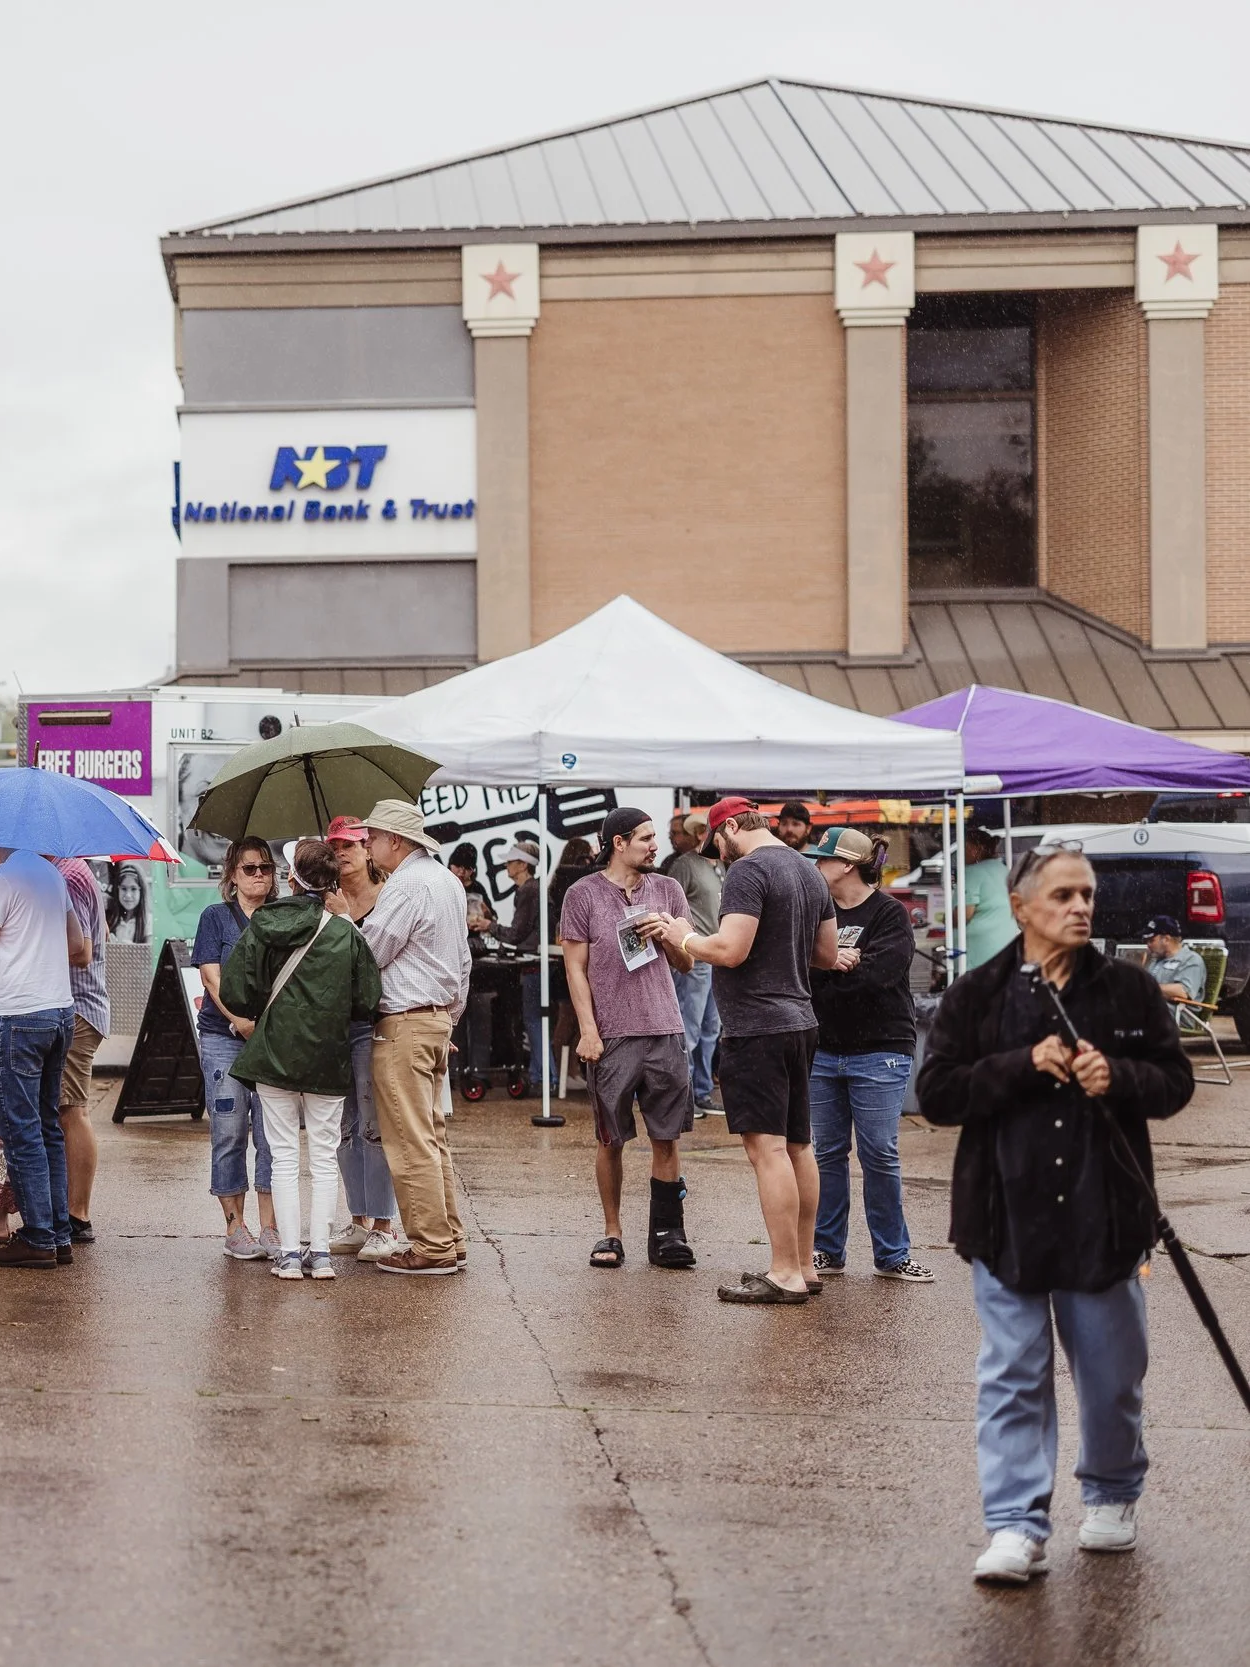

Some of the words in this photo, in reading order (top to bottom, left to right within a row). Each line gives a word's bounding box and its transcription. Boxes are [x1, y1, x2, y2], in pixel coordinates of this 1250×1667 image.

[184, 500, 294, 522] National
[303, 500, 369, 521] Bank
[382, 500, 397, 519] &
[409, 499, 476, 520] Trust
[171, 728, 196, 739] UNIT
[38, 750, 71, 777] FREE
[74, 750, 143, 780] BURGERS
